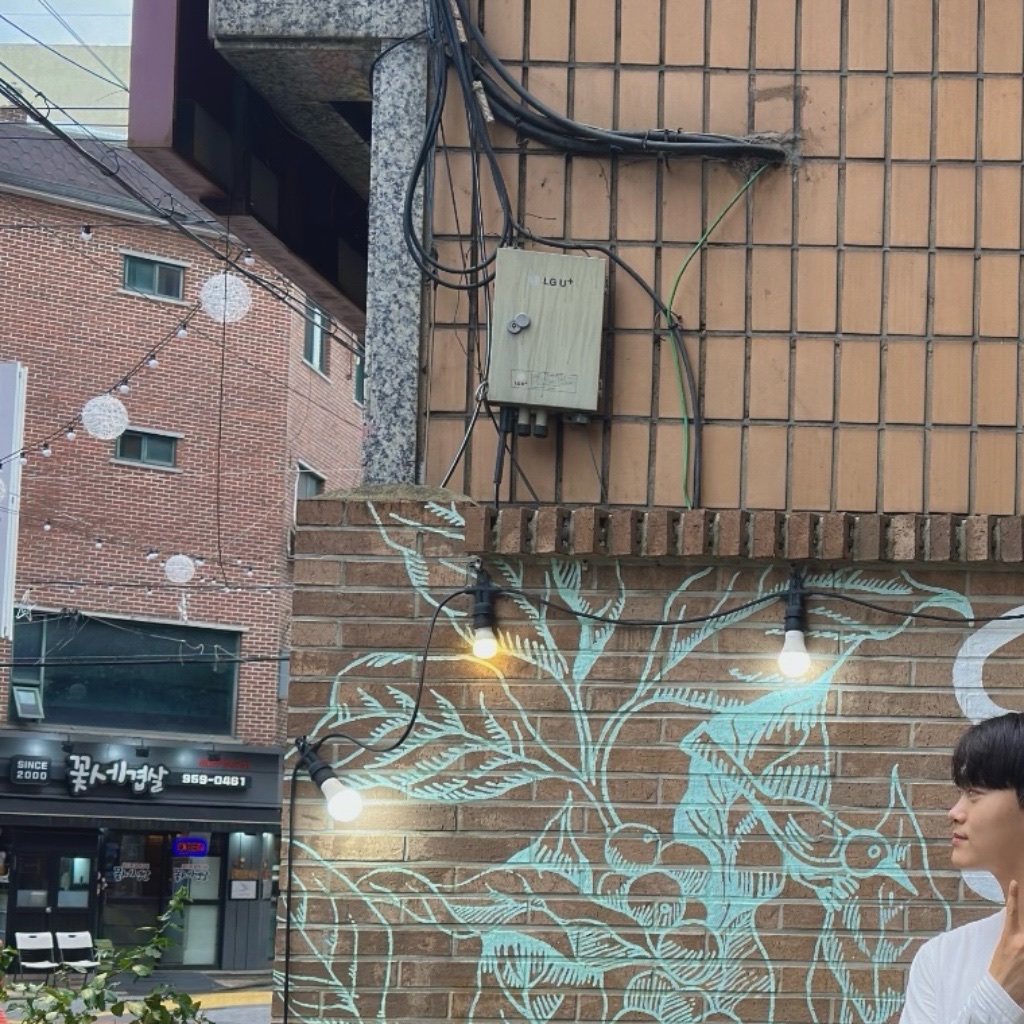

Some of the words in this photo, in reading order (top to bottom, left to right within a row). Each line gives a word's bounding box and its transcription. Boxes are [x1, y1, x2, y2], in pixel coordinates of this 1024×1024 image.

[543, 276, 557, 287] LG
[17, 760, 48, 770] SINCE
[16, 771, 47, 780] 2000
